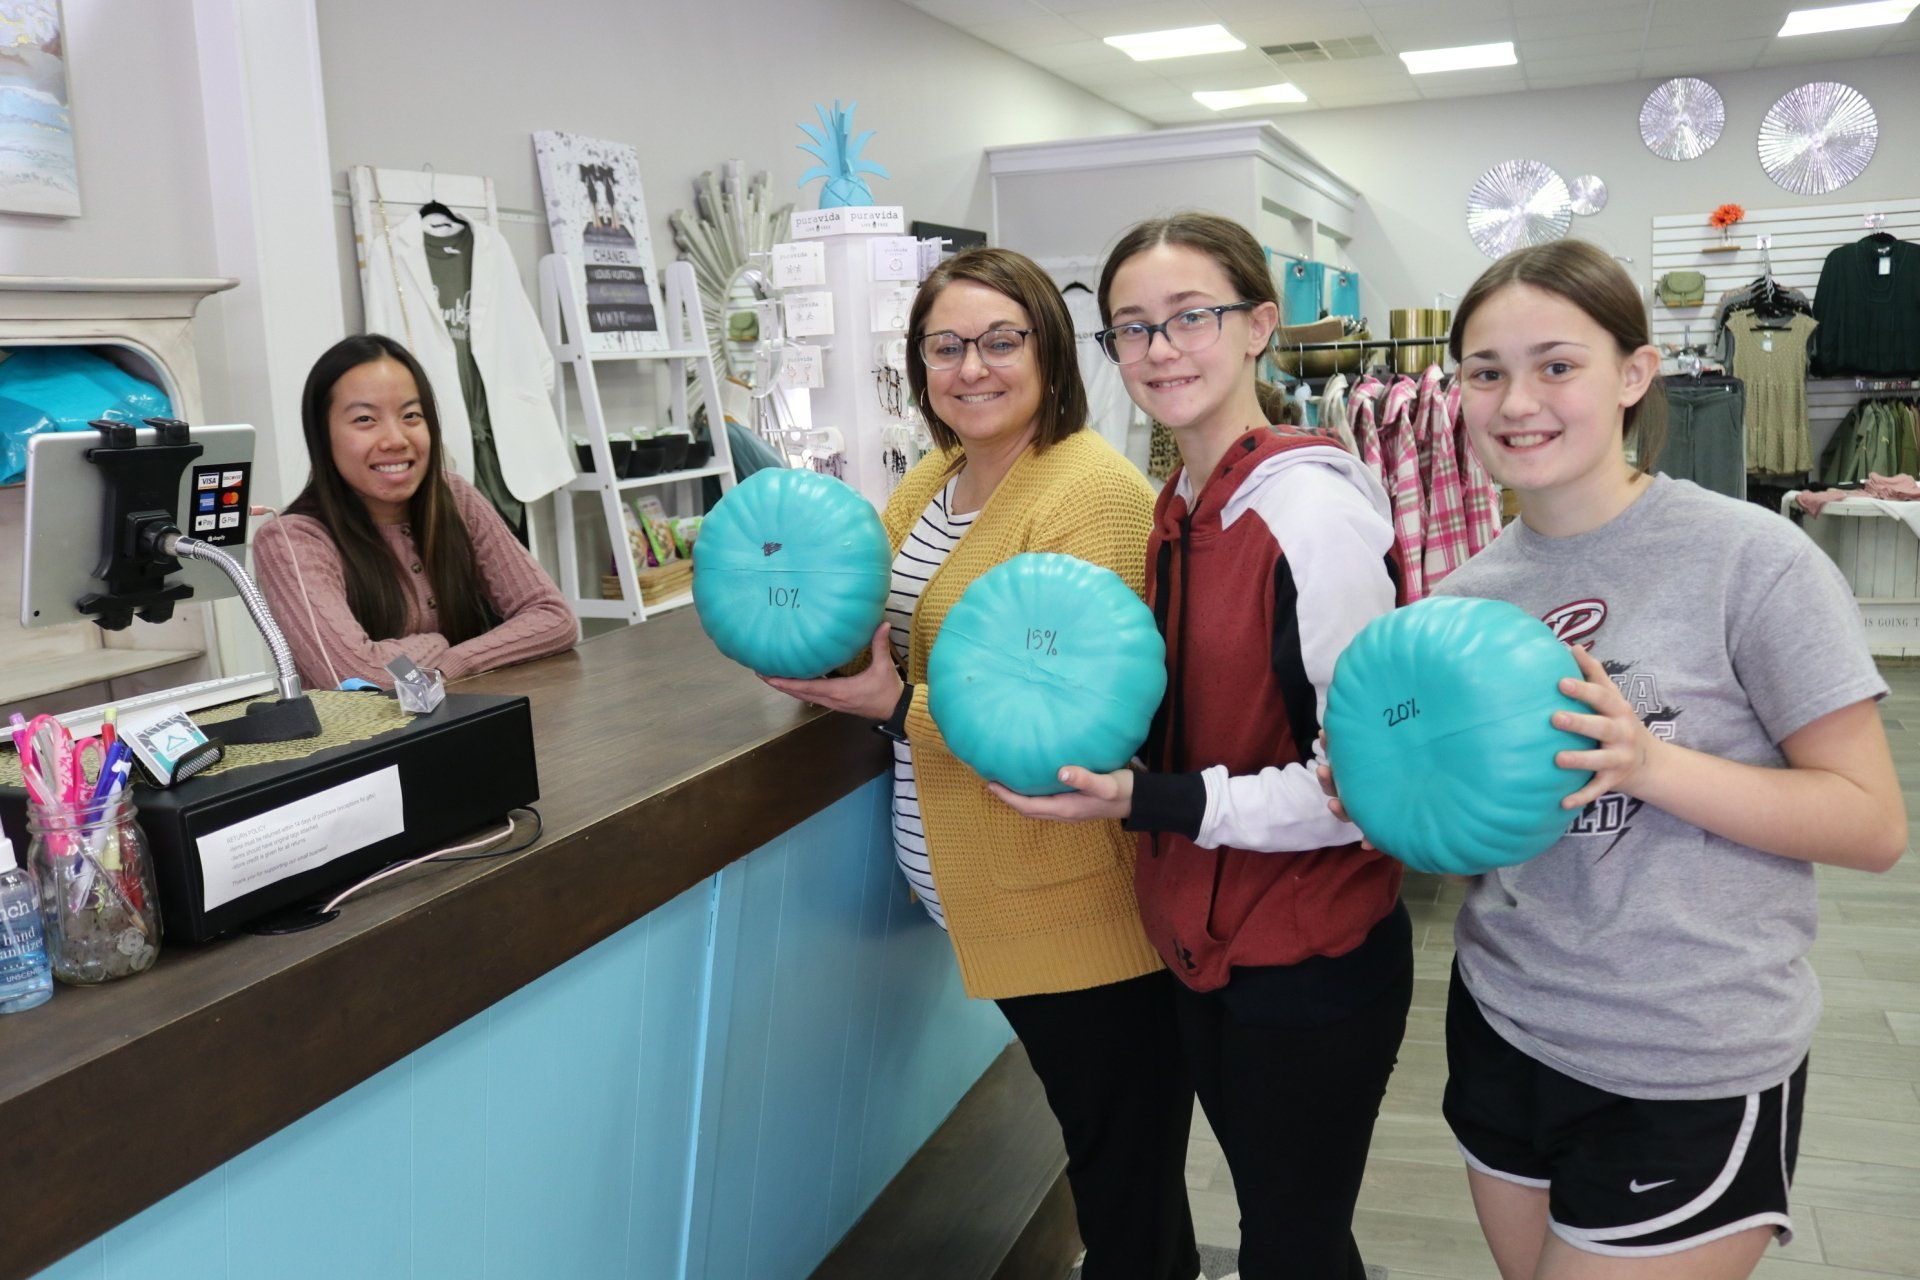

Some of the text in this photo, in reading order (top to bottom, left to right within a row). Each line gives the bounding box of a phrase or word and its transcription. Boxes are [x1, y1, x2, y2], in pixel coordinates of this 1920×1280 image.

[795, 212, 840, 228] puravida
[850, 211, 898, 222] puravida
[593, 249, 630, 264] CHANEL
[203, 519, 214, 527] Pay
[769, 586, 801, 609] 10%
[1877, 617, 1909, 628] GOING
[1026, 627, 1058, 656] 15%
[1383, 698, 1420, 727] 20%
[226, 824, 266, 844] RETURN POLICY
[0, 937, 43, 959] anitizer
